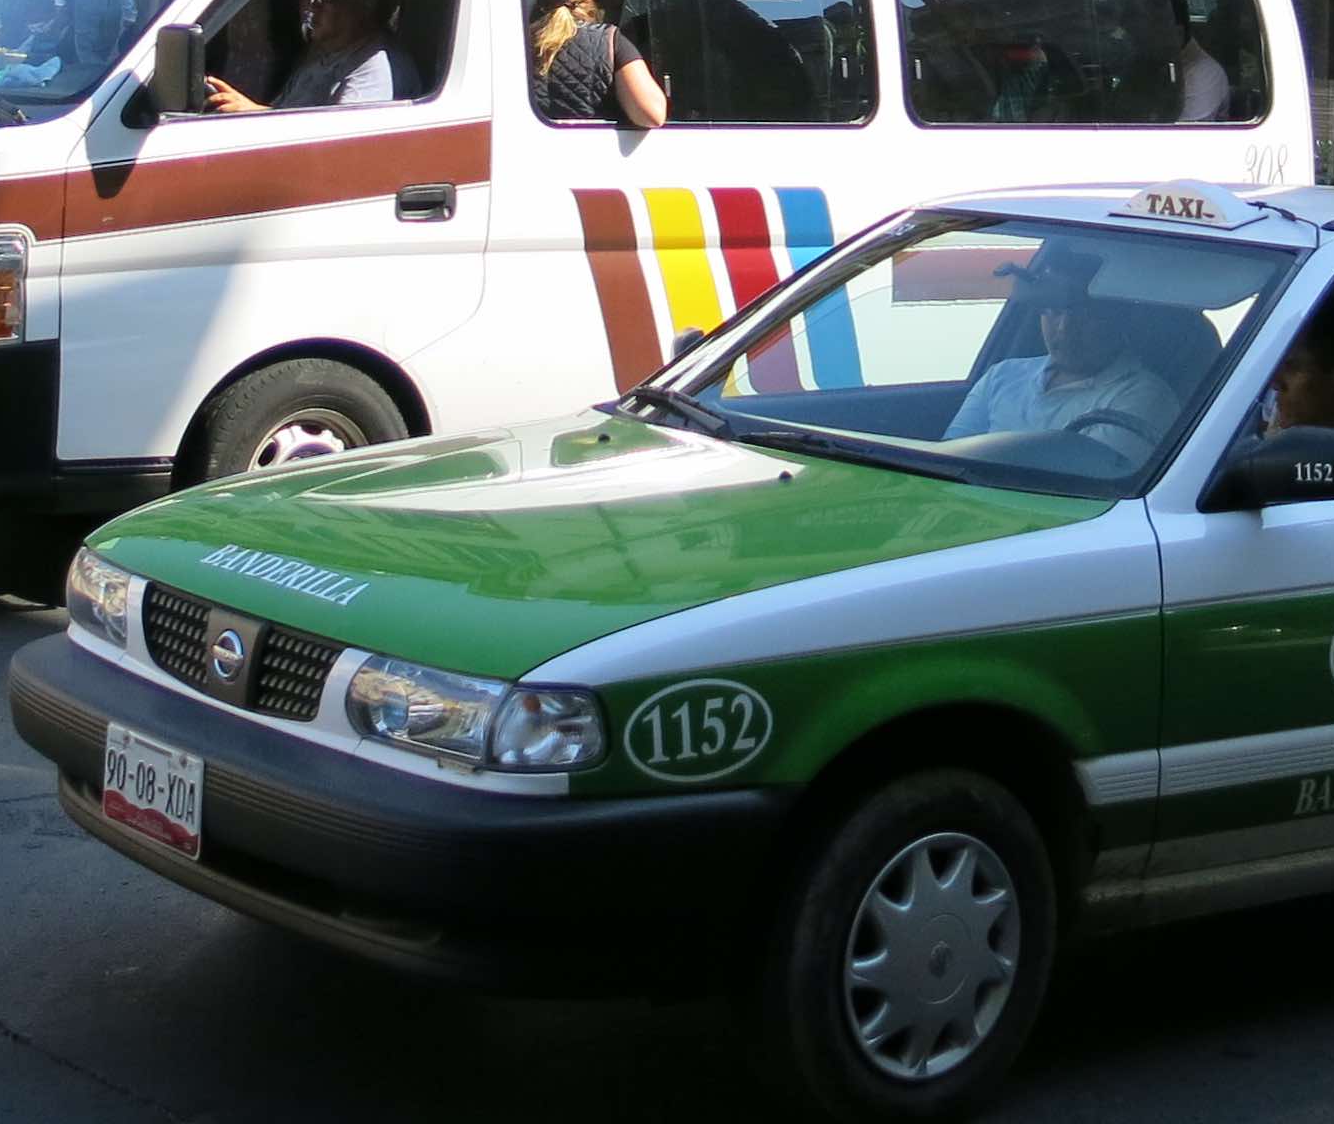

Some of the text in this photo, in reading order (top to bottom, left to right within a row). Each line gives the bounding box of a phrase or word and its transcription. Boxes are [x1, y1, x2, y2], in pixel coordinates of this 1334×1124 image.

[1146, 193, 1204, 220] TAXI
[1294, 462, 1334, 483] 1152
[199, 543, 370, 608] BANDERILLA
[640, 692, 758, 764] 1152
[107, 749, 196, 825] 90-08-XDA
